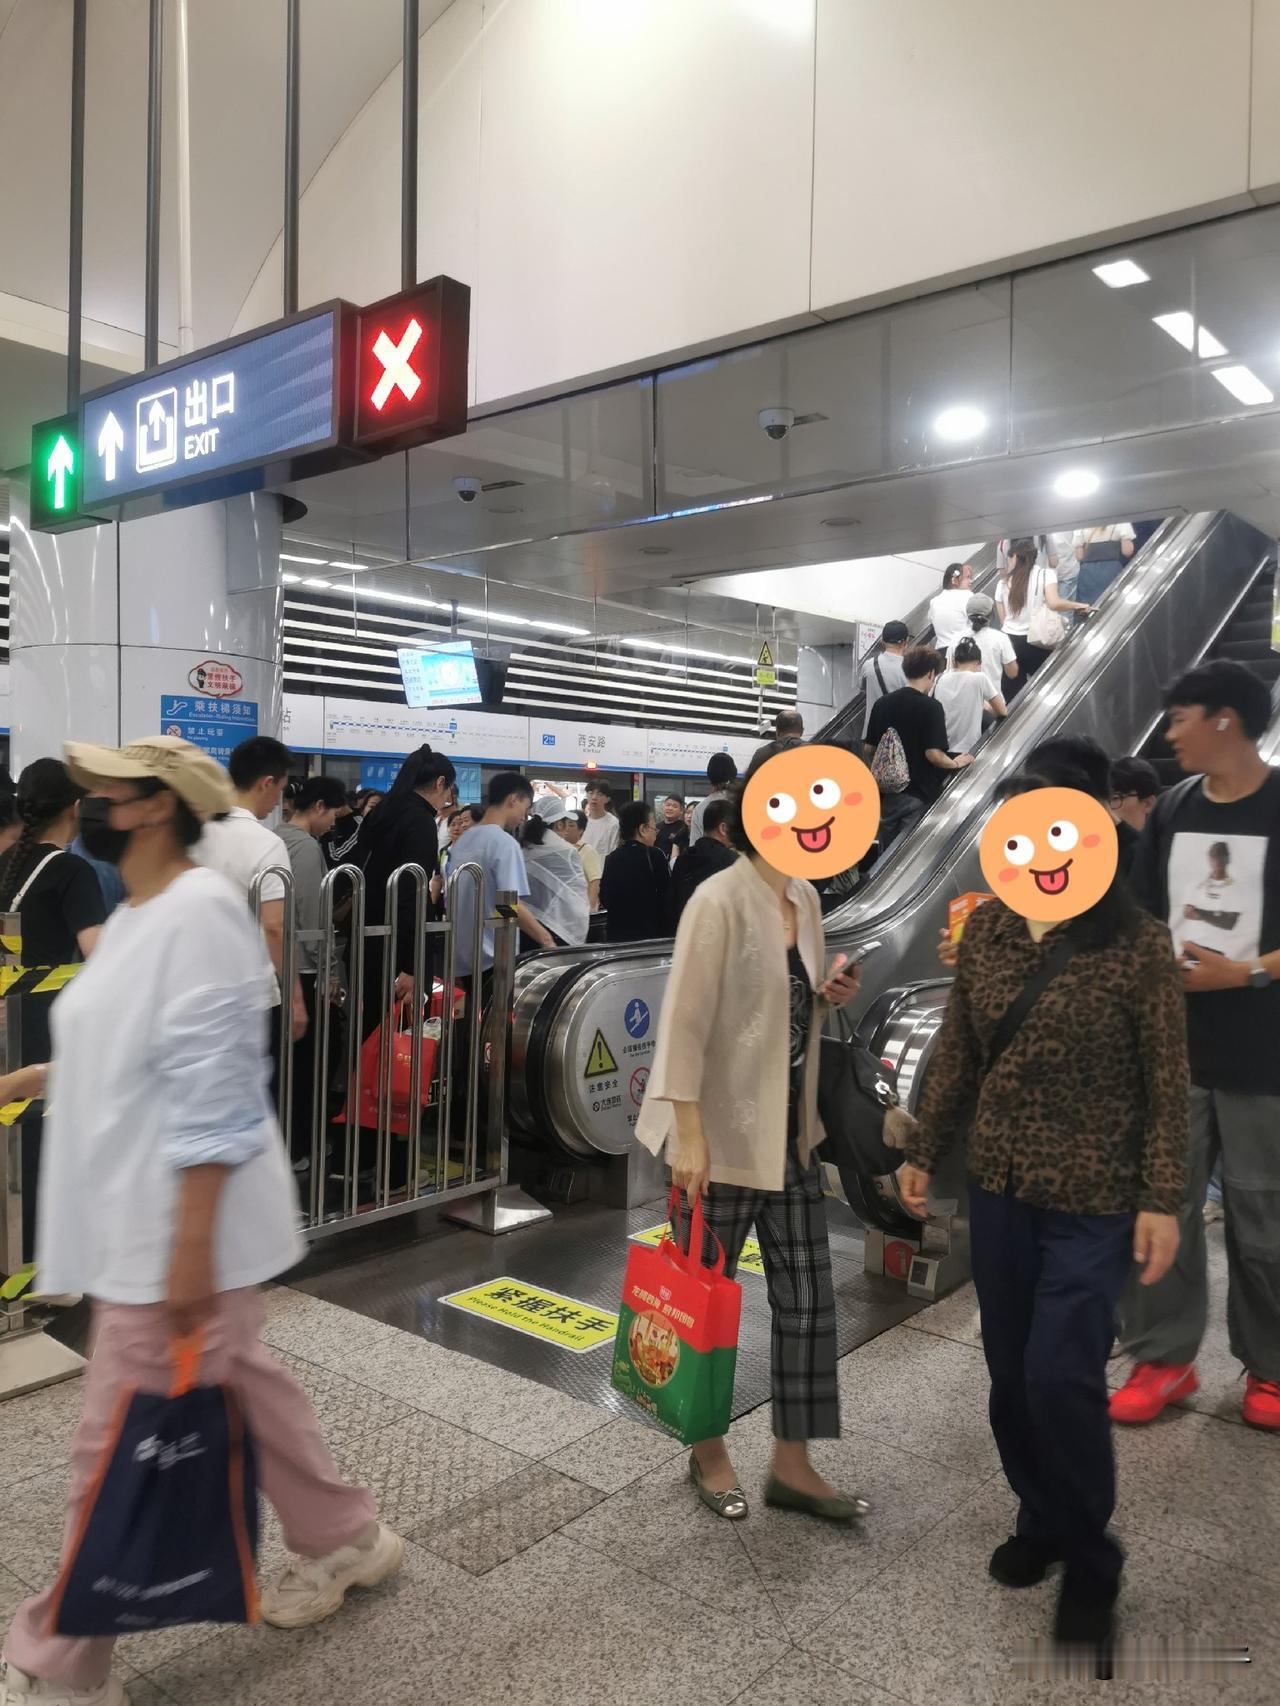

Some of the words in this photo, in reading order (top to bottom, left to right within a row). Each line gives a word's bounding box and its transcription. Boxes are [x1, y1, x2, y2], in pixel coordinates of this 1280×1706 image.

[185, 372, 234, 428] 出口
[185, 428, 220, 460] EXIT
[194, 700, 251, 715] 乘扶梯须知
[578, 734, 606, 748] 西安路
[589, 1079, 618, 1094] 注意安全
[468, 1296, 498, 1310] Please
[498, 1307, 521, 1319] Hold
[521, 1315, 539, 1325] the
[539, 1322, 585, 1342] Handrail
[484, 1286, 614, 1332] 紧握扶手
